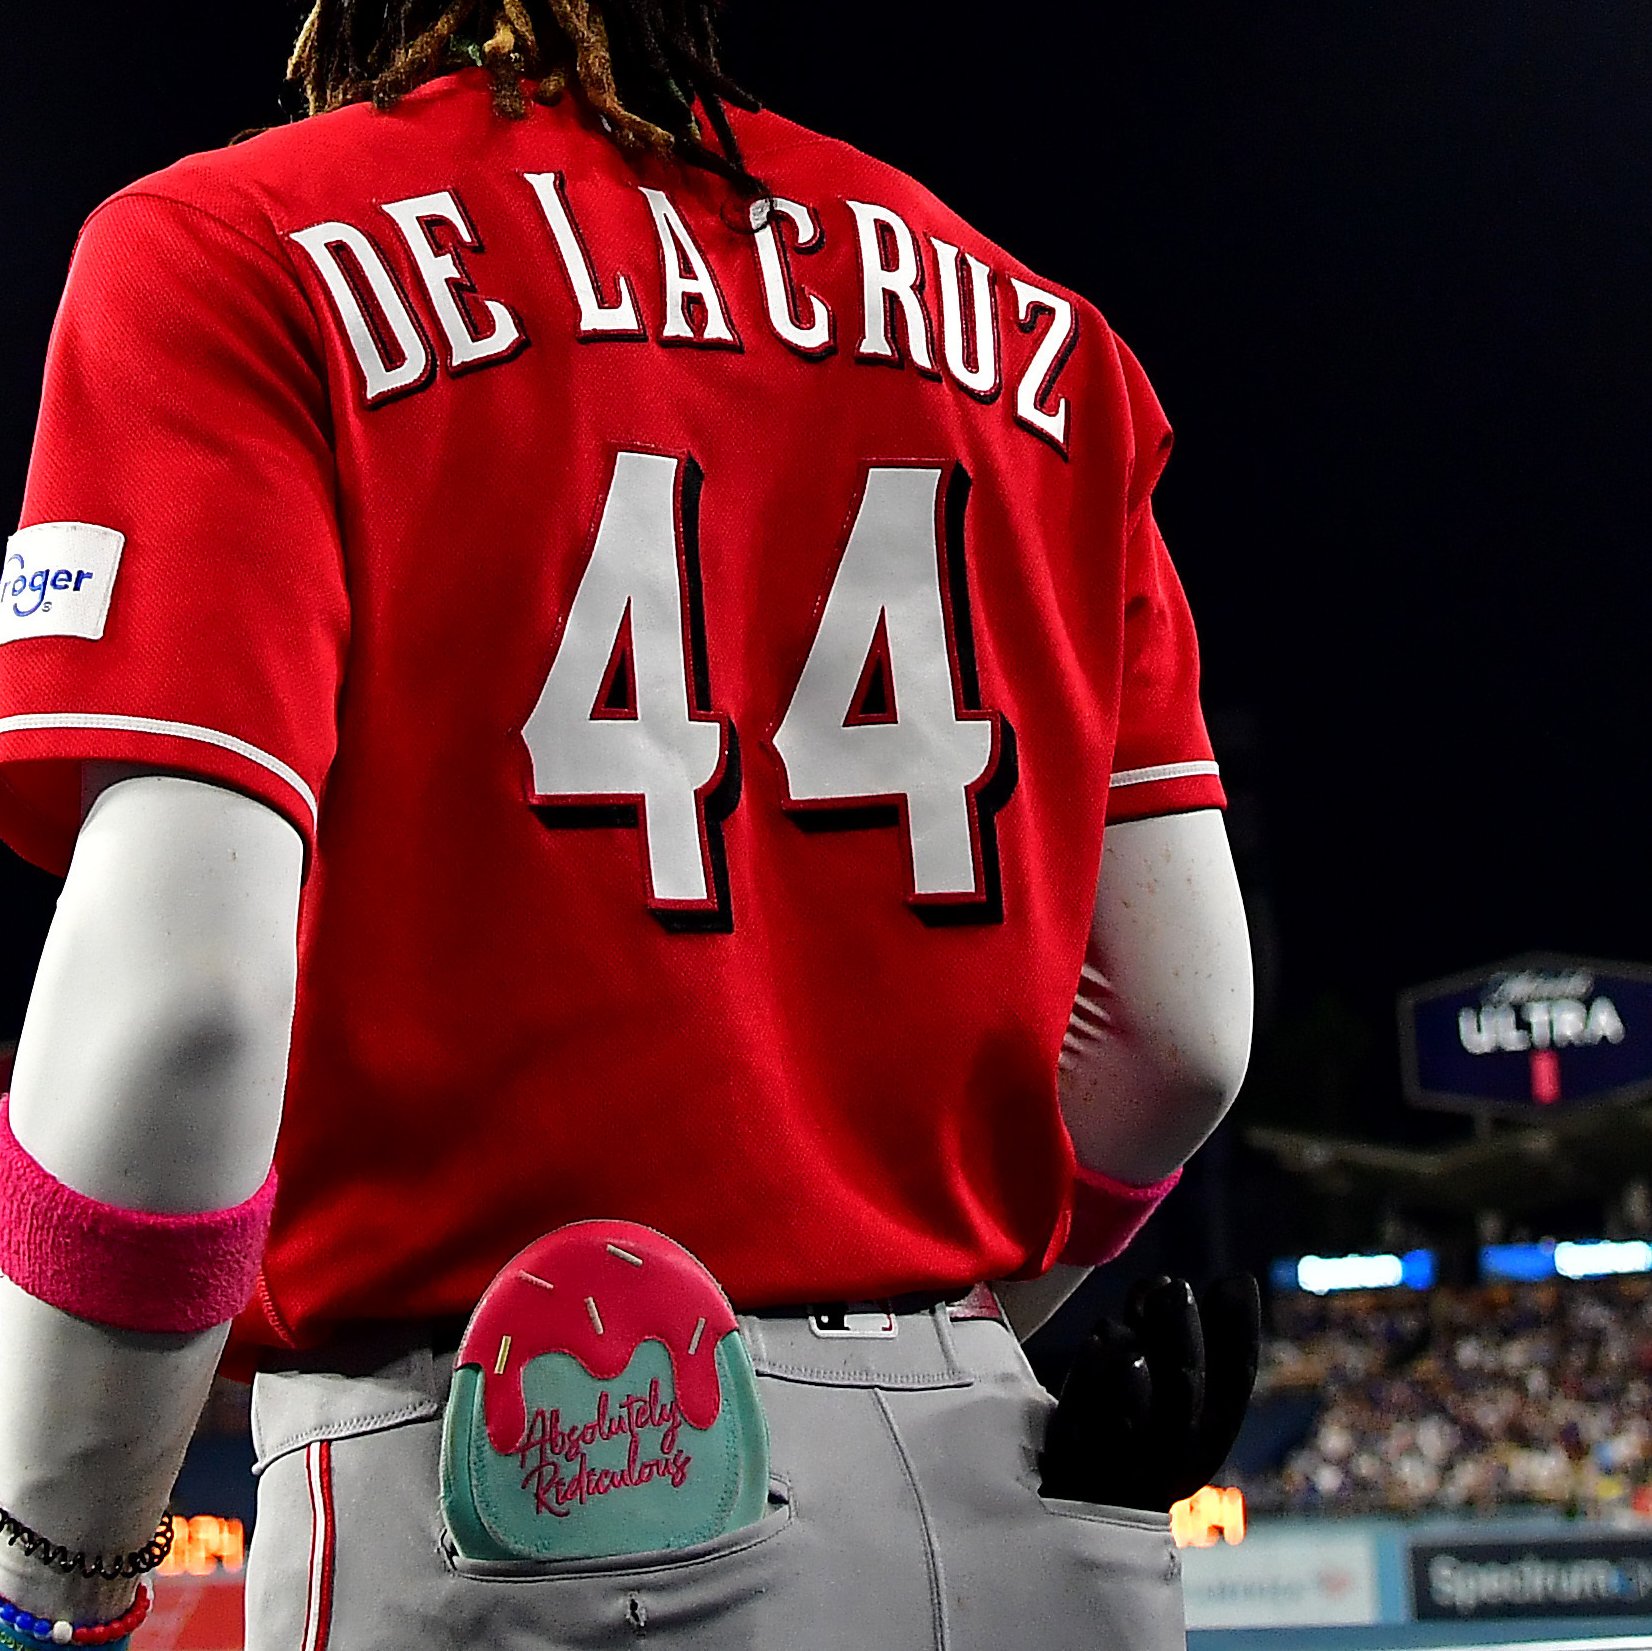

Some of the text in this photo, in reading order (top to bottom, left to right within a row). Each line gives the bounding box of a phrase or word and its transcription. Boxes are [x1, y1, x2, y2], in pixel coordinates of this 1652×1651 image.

[289, 171, 1081, 459] DE LA CRUZ
[515, 444, 1011, 924] 44
[1458, 997, 1625, 1055] ULTRA
[520, 1378, 682, 1464] Absolutely
[523, 1447, 691, 1518] Ridiculous
[1428, 1554, 1611, 1614] Spectrum
